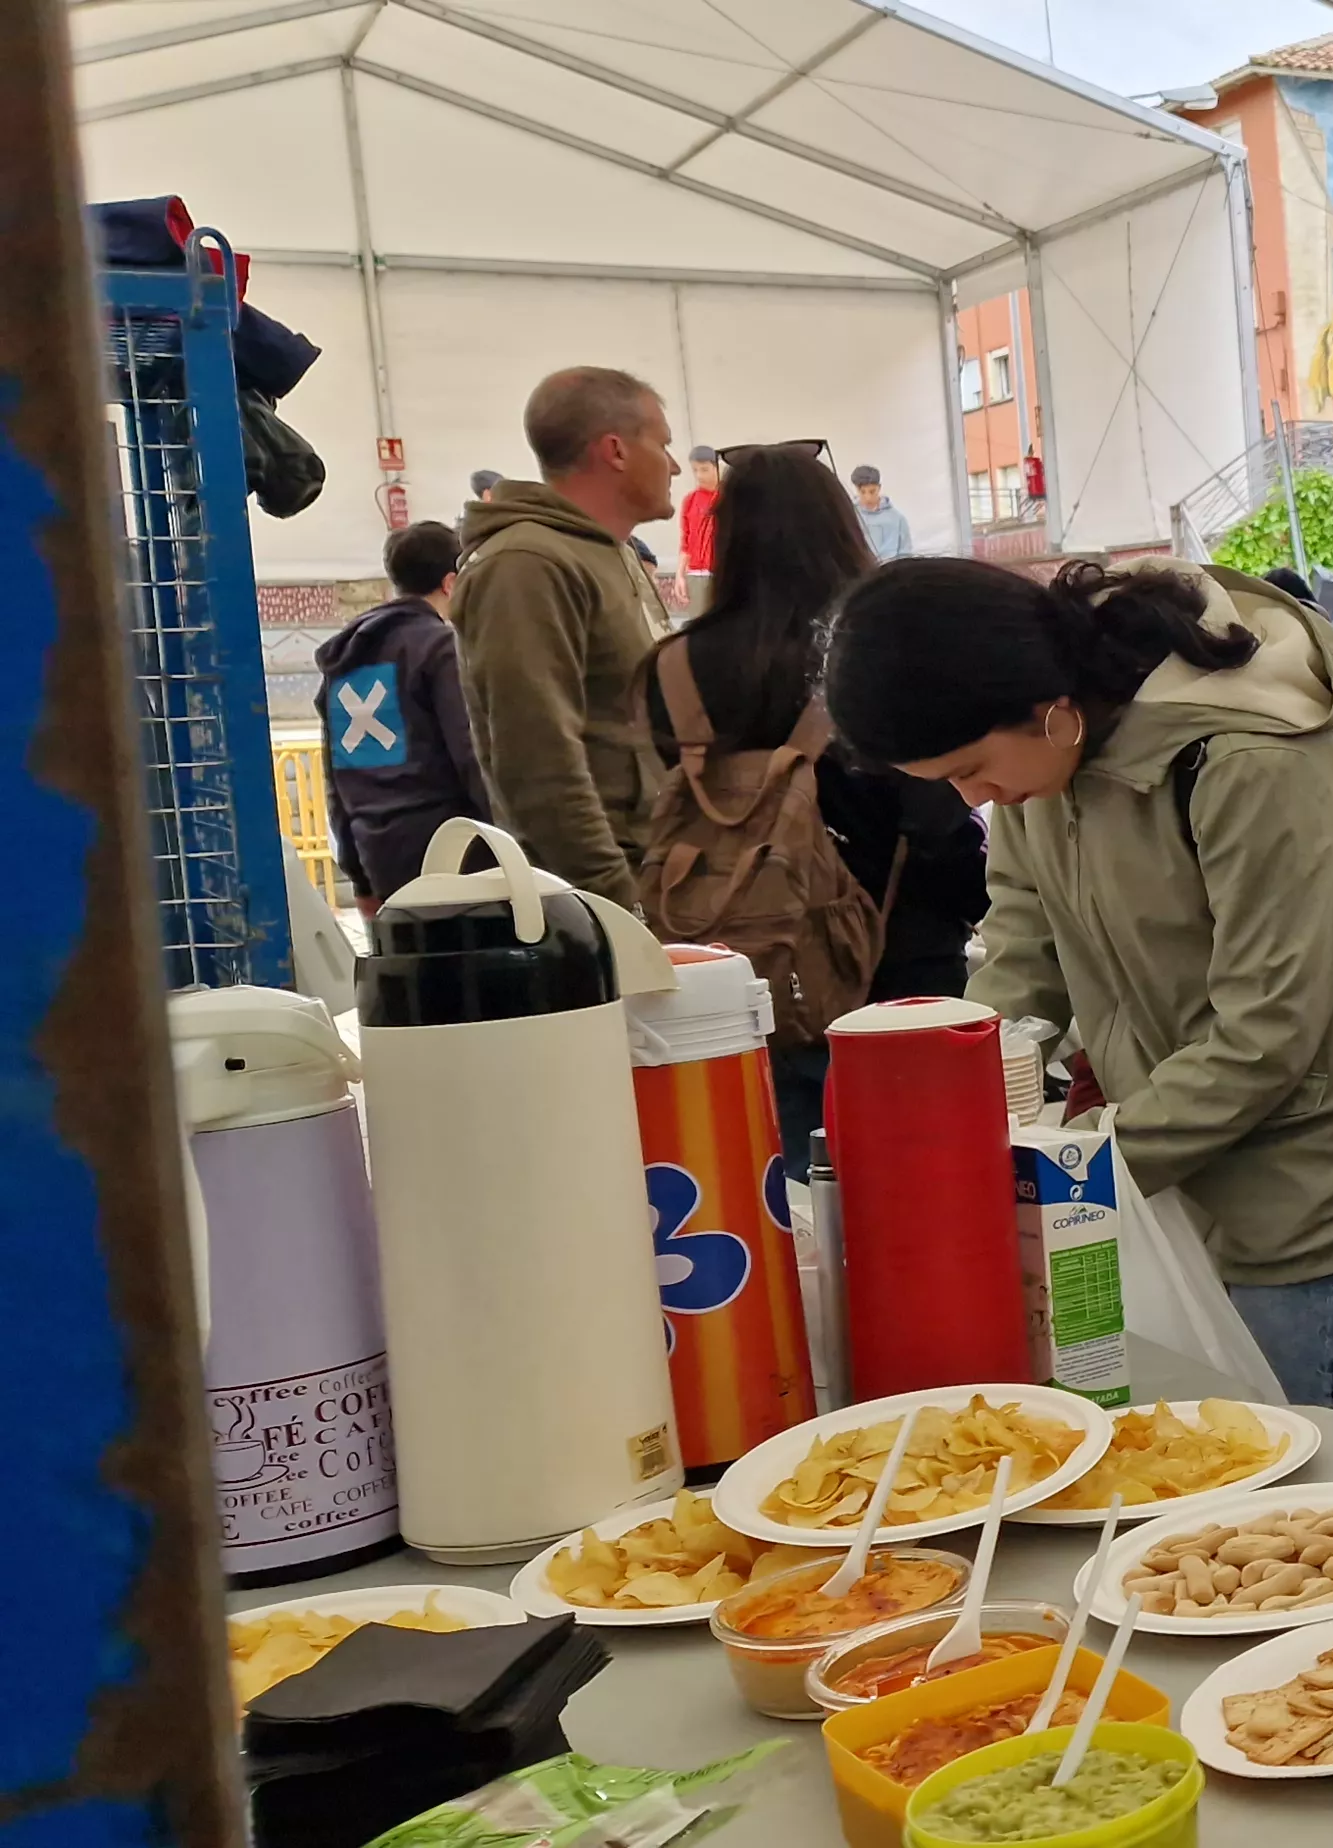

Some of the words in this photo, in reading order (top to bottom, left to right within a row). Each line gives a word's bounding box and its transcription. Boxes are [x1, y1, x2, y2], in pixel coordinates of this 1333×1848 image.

[1053, 1210, 1105, 1230] COPIRINEO
[224, 1488, 293, 1509] OFFEE
[284, 1508, 360, 1532] coffee
